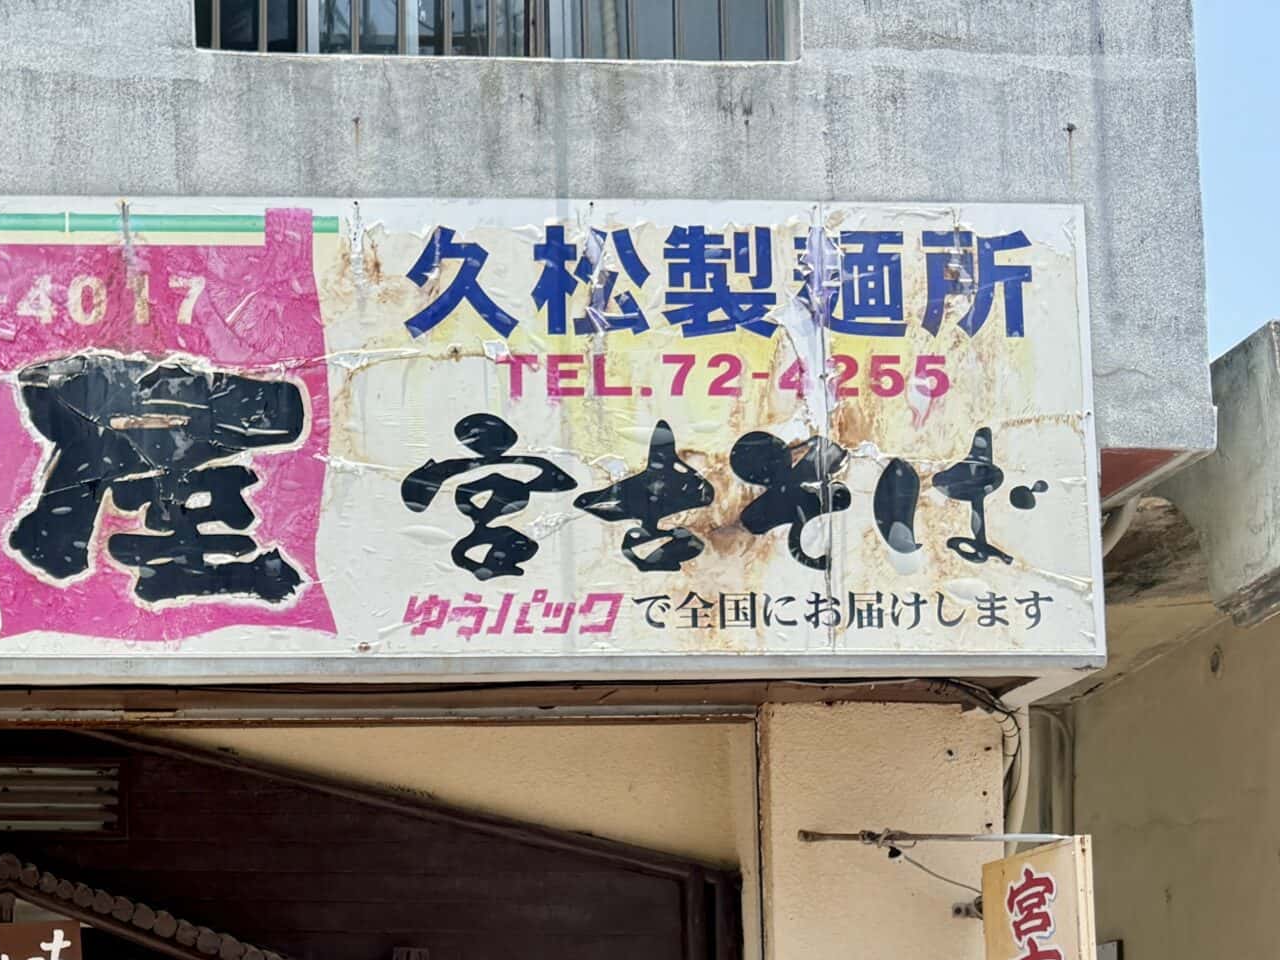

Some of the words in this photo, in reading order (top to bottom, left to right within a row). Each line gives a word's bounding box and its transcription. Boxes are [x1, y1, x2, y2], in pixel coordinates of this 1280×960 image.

[403, 223, 1034, 340] 久松製麺所
[401, 412, 1050, 583] 宮古そば
